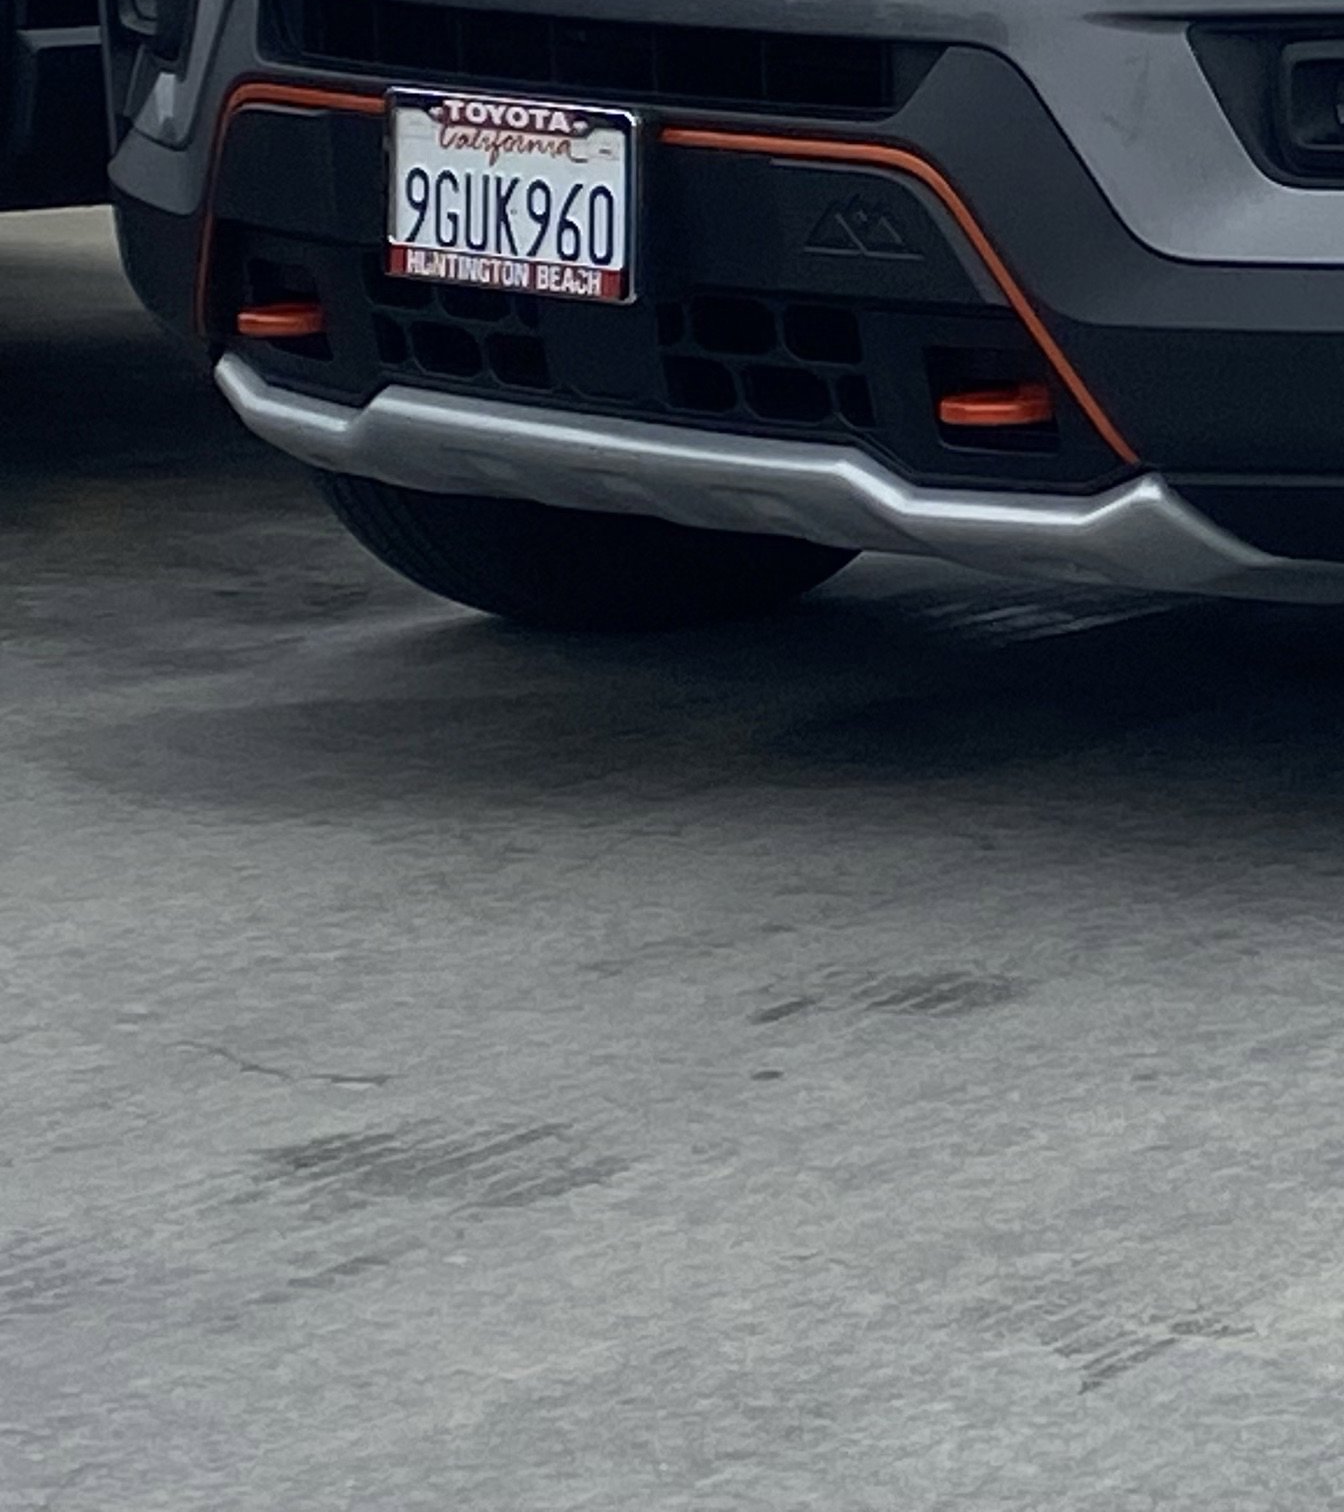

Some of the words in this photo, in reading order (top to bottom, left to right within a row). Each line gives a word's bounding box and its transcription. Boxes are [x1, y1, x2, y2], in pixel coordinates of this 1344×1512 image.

[443, 99, 571, 134] TOYOTA
[439, 125, 588, 166] California
[405, 167, 614, 266] 9GUK960
[405, 249, 529, 288] HUNTINGTON
[536, 265, 602, 296] BEACH
